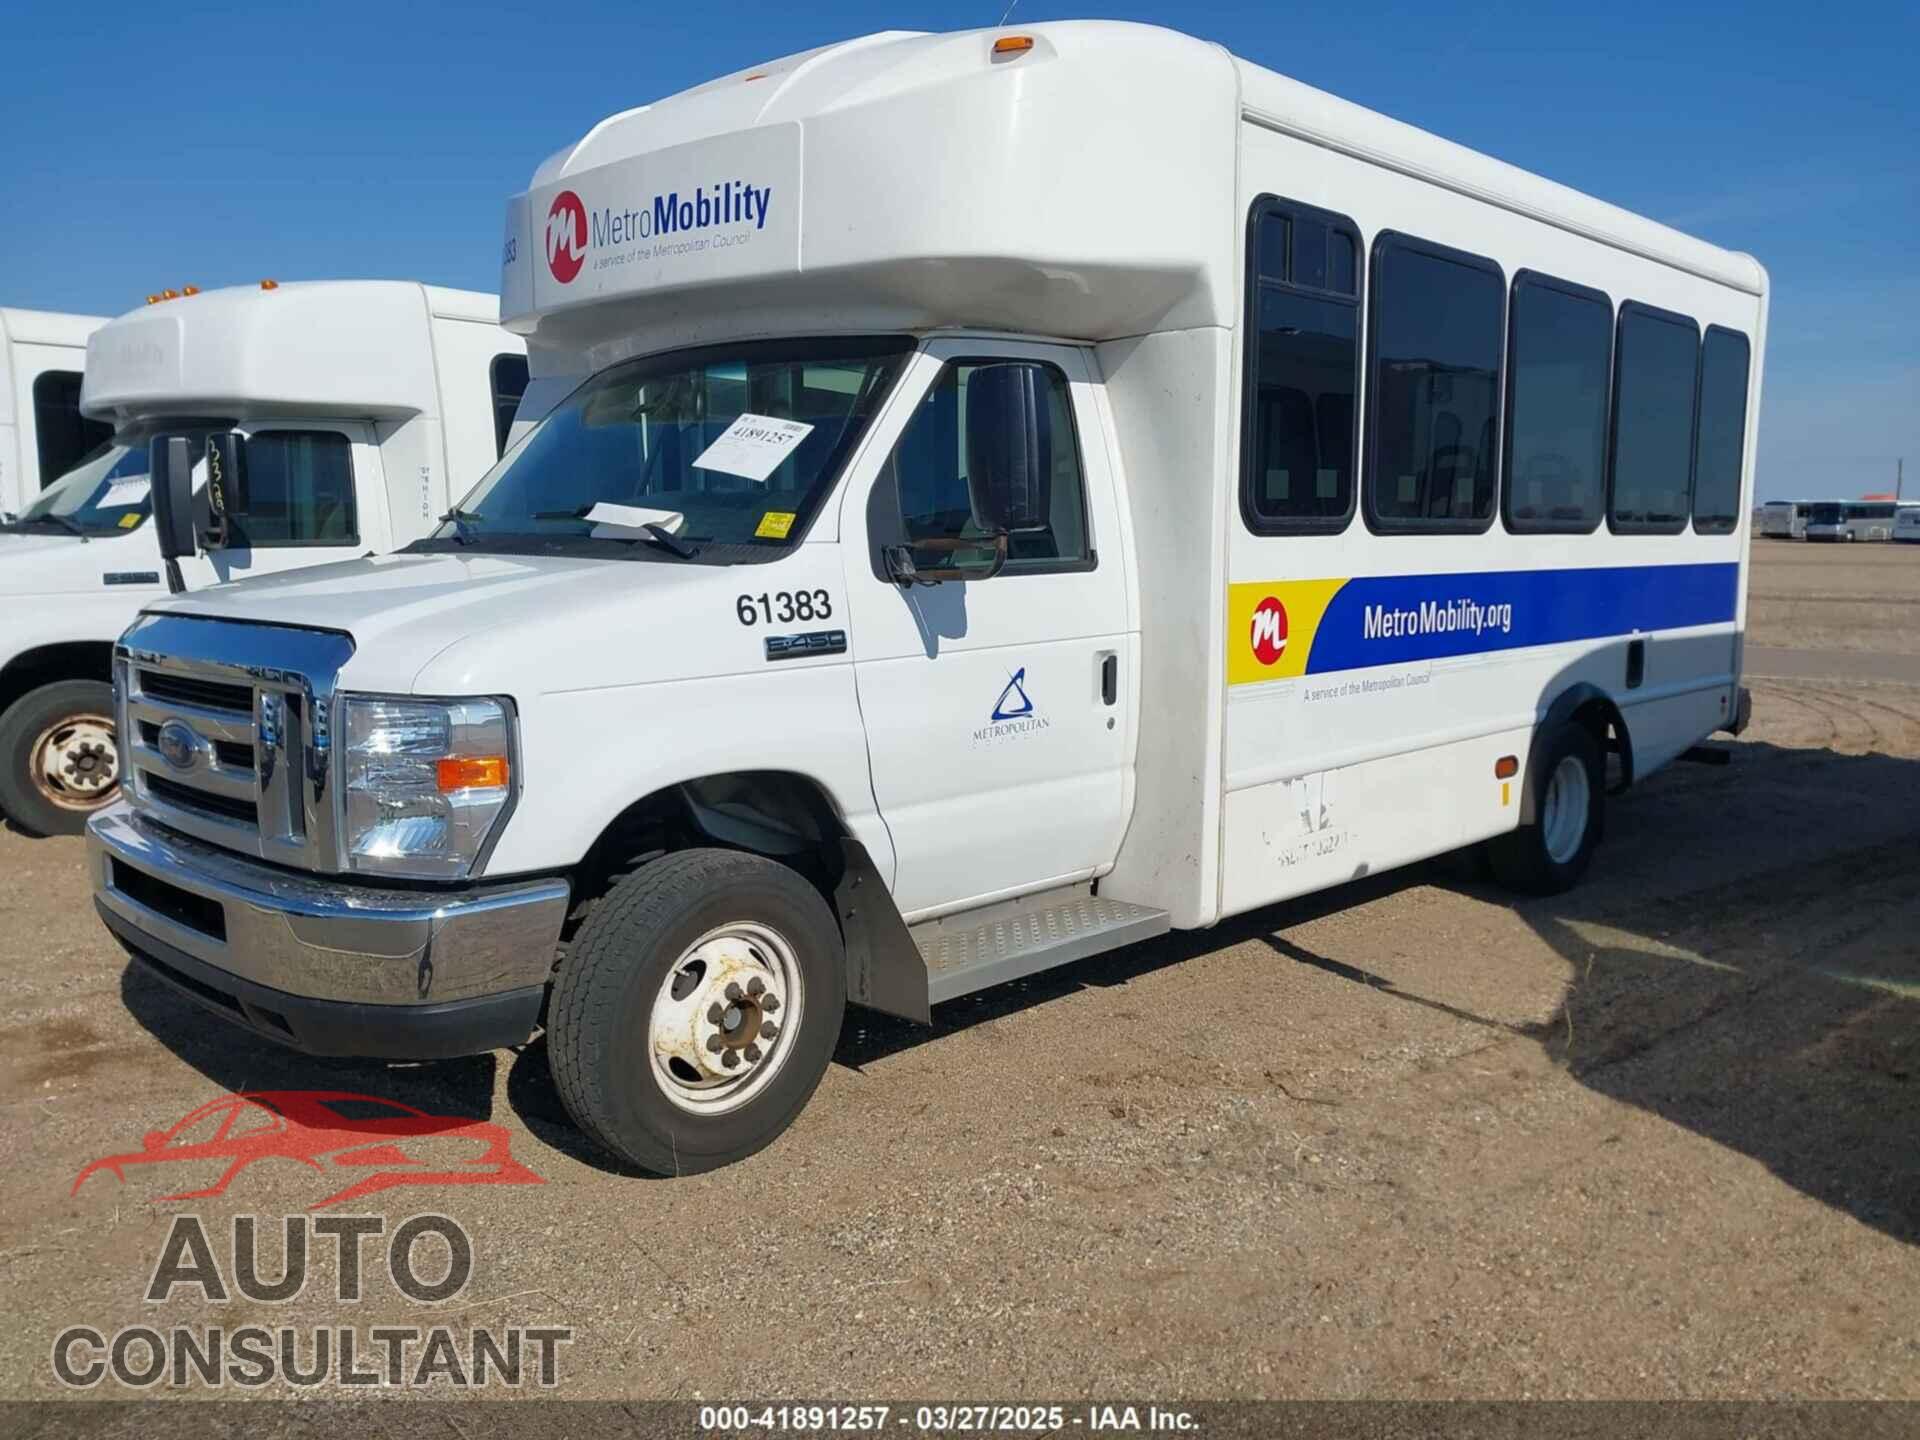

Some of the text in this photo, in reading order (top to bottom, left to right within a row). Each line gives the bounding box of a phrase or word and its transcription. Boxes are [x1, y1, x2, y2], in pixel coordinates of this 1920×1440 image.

[592, 180, 772, 249] MetroMobility
[599, 254, 625, 270] service
[627, 251, 635, 264] of
[637, 248, 650, 261] the
[653, 239, 710, 257] Metropolitan
[713, 231, 751, 249] Council
[736, 589, 832, 626] 61383
[1364, 599, 1512, 640] MetroMobility.org
[1304, 672, 1432, 702] A service of the Metropolitan Council
[974, 718, 1049, 740] METROPOLITAN
